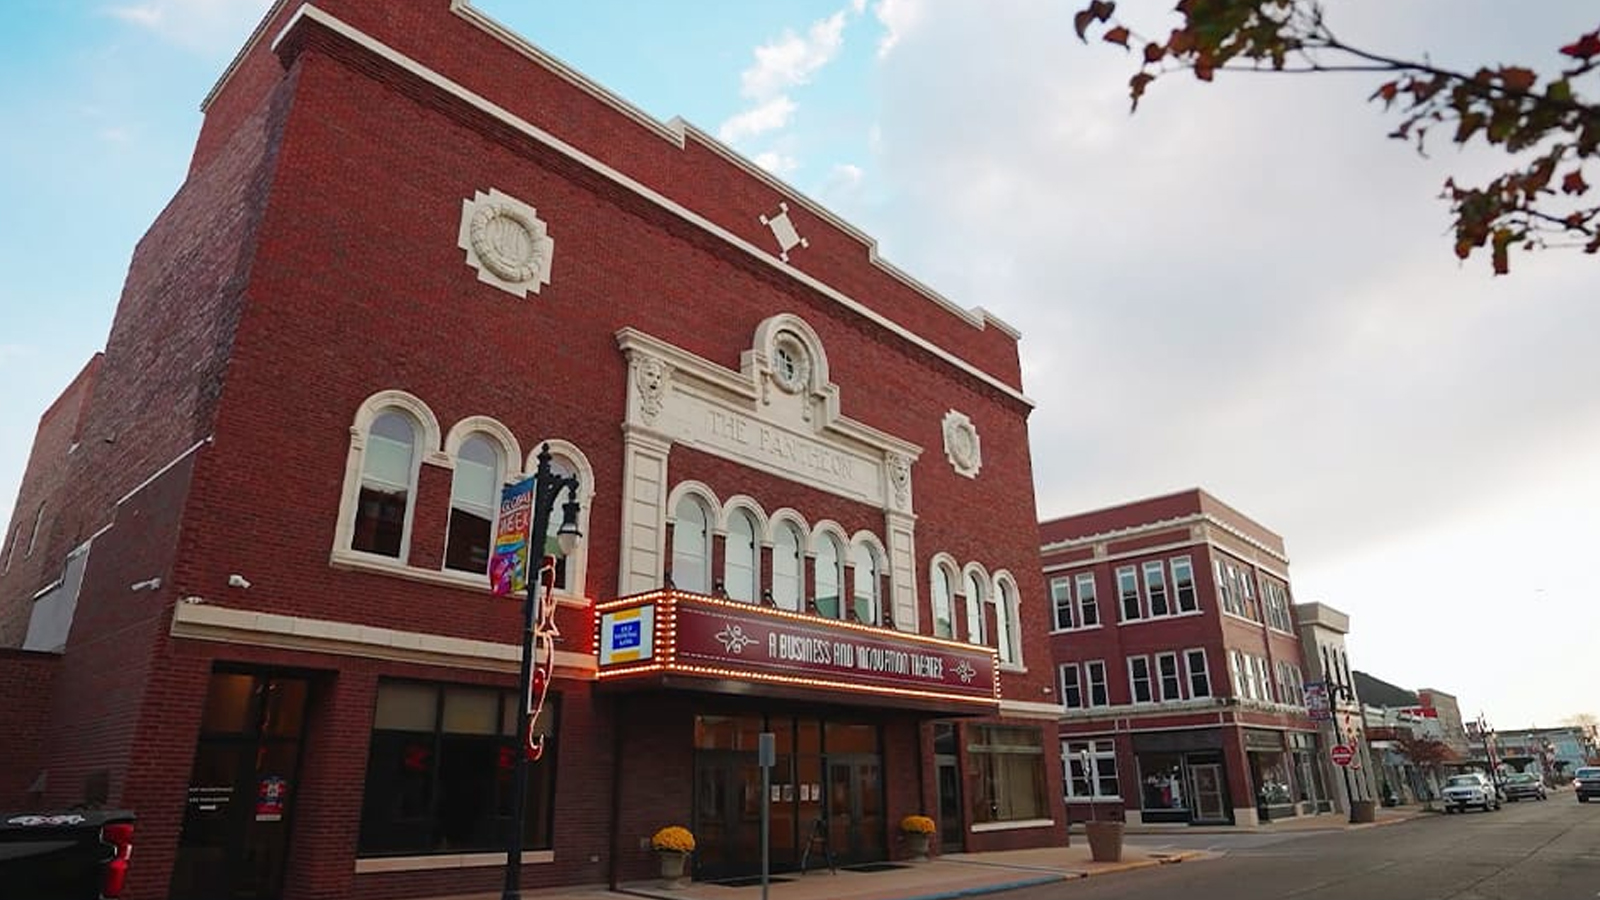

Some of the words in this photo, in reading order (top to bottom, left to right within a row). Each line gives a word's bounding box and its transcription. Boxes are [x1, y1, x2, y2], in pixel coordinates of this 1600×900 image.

[707, 409, 748, 446] THE
[768, 632, 778, 659] A
[780, 634, 832, 665] BUSINESS
[833, 642, 854, 668] AND
